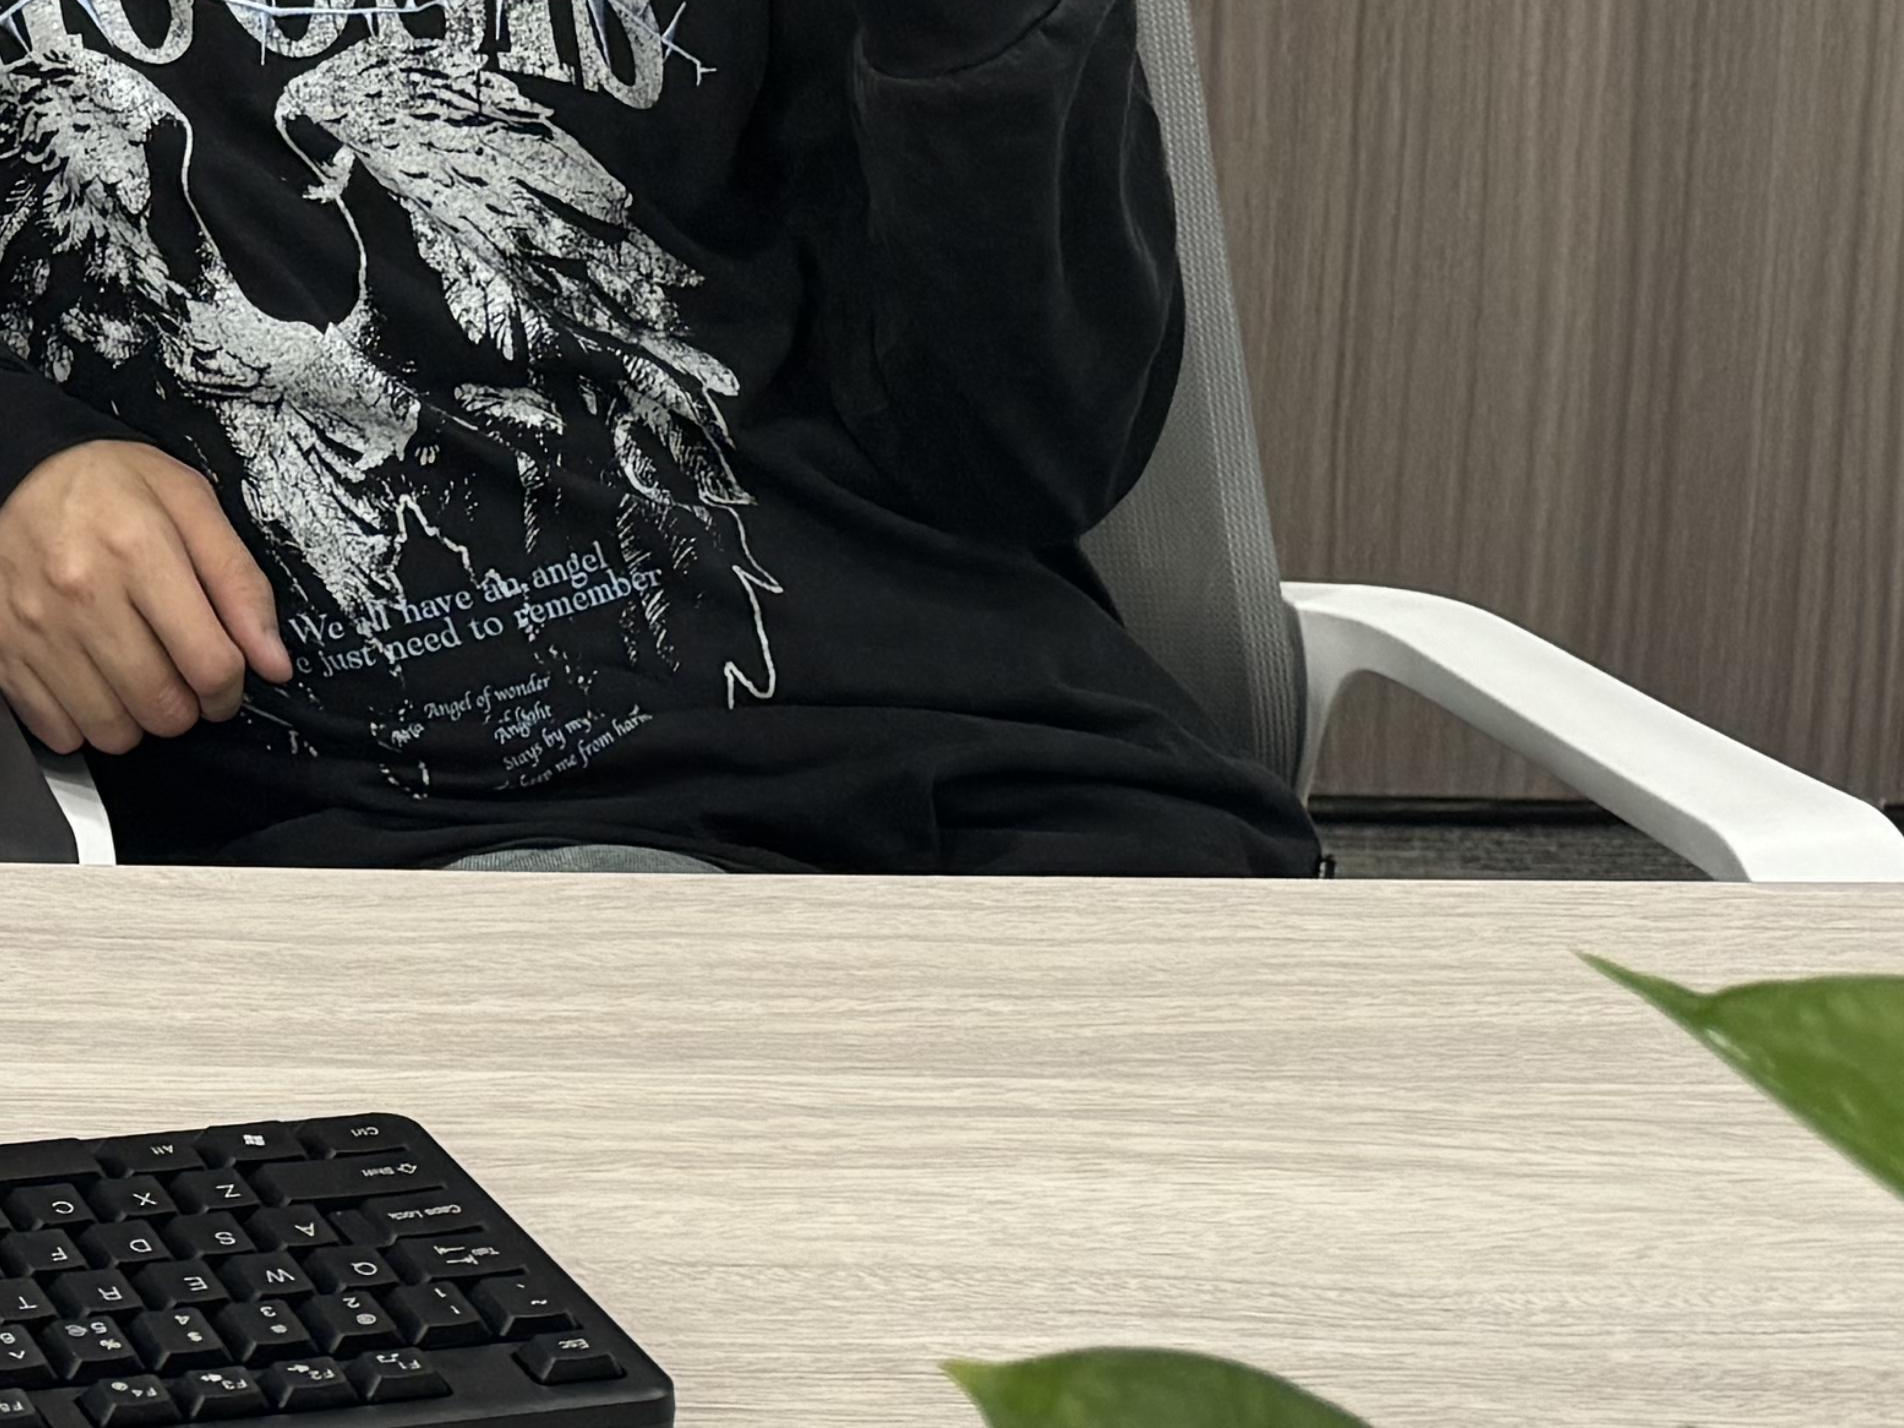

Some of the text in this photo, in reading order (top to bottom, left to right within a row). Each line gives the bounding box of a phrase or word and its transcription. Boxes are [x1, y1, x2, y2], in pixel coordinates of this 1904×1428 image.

[288, 613, 345, 647] We
[352, 599, 391, 638] all
[400, 590, 474, 624] have
[532, 540, 608, 589] angel
[318, 568, 663, 677] just need to remember
[424, 672, 552, 721] Angel of wonder
[503, 743, 542, 771] Stays
[542, 725, 565, 750] by
[577, 736, 615, 769] from
[215, 1183, 241, 1199] Z
[132, 1192, 157, 1206] X
[52, 1200, 75, 1215] C
[294, 1222, 315, 1237] A
[129, 1238, 153, 1253] D
[214, 1231, 236, 1245] S
[51, 1246, 68, 1262] F
[265, 1268, 295, 1284] W
[350, 1261, 378, 1276] Q
[183, 1276, 209, 1291] E
[97, 1286, 123, 1302] R
[18, 1296, 38, 1310] T
[342, 1297, 360, 1310] 2
[260, 1306, 276, 1318] 3
[174, 1314, 190, 1326] 4
